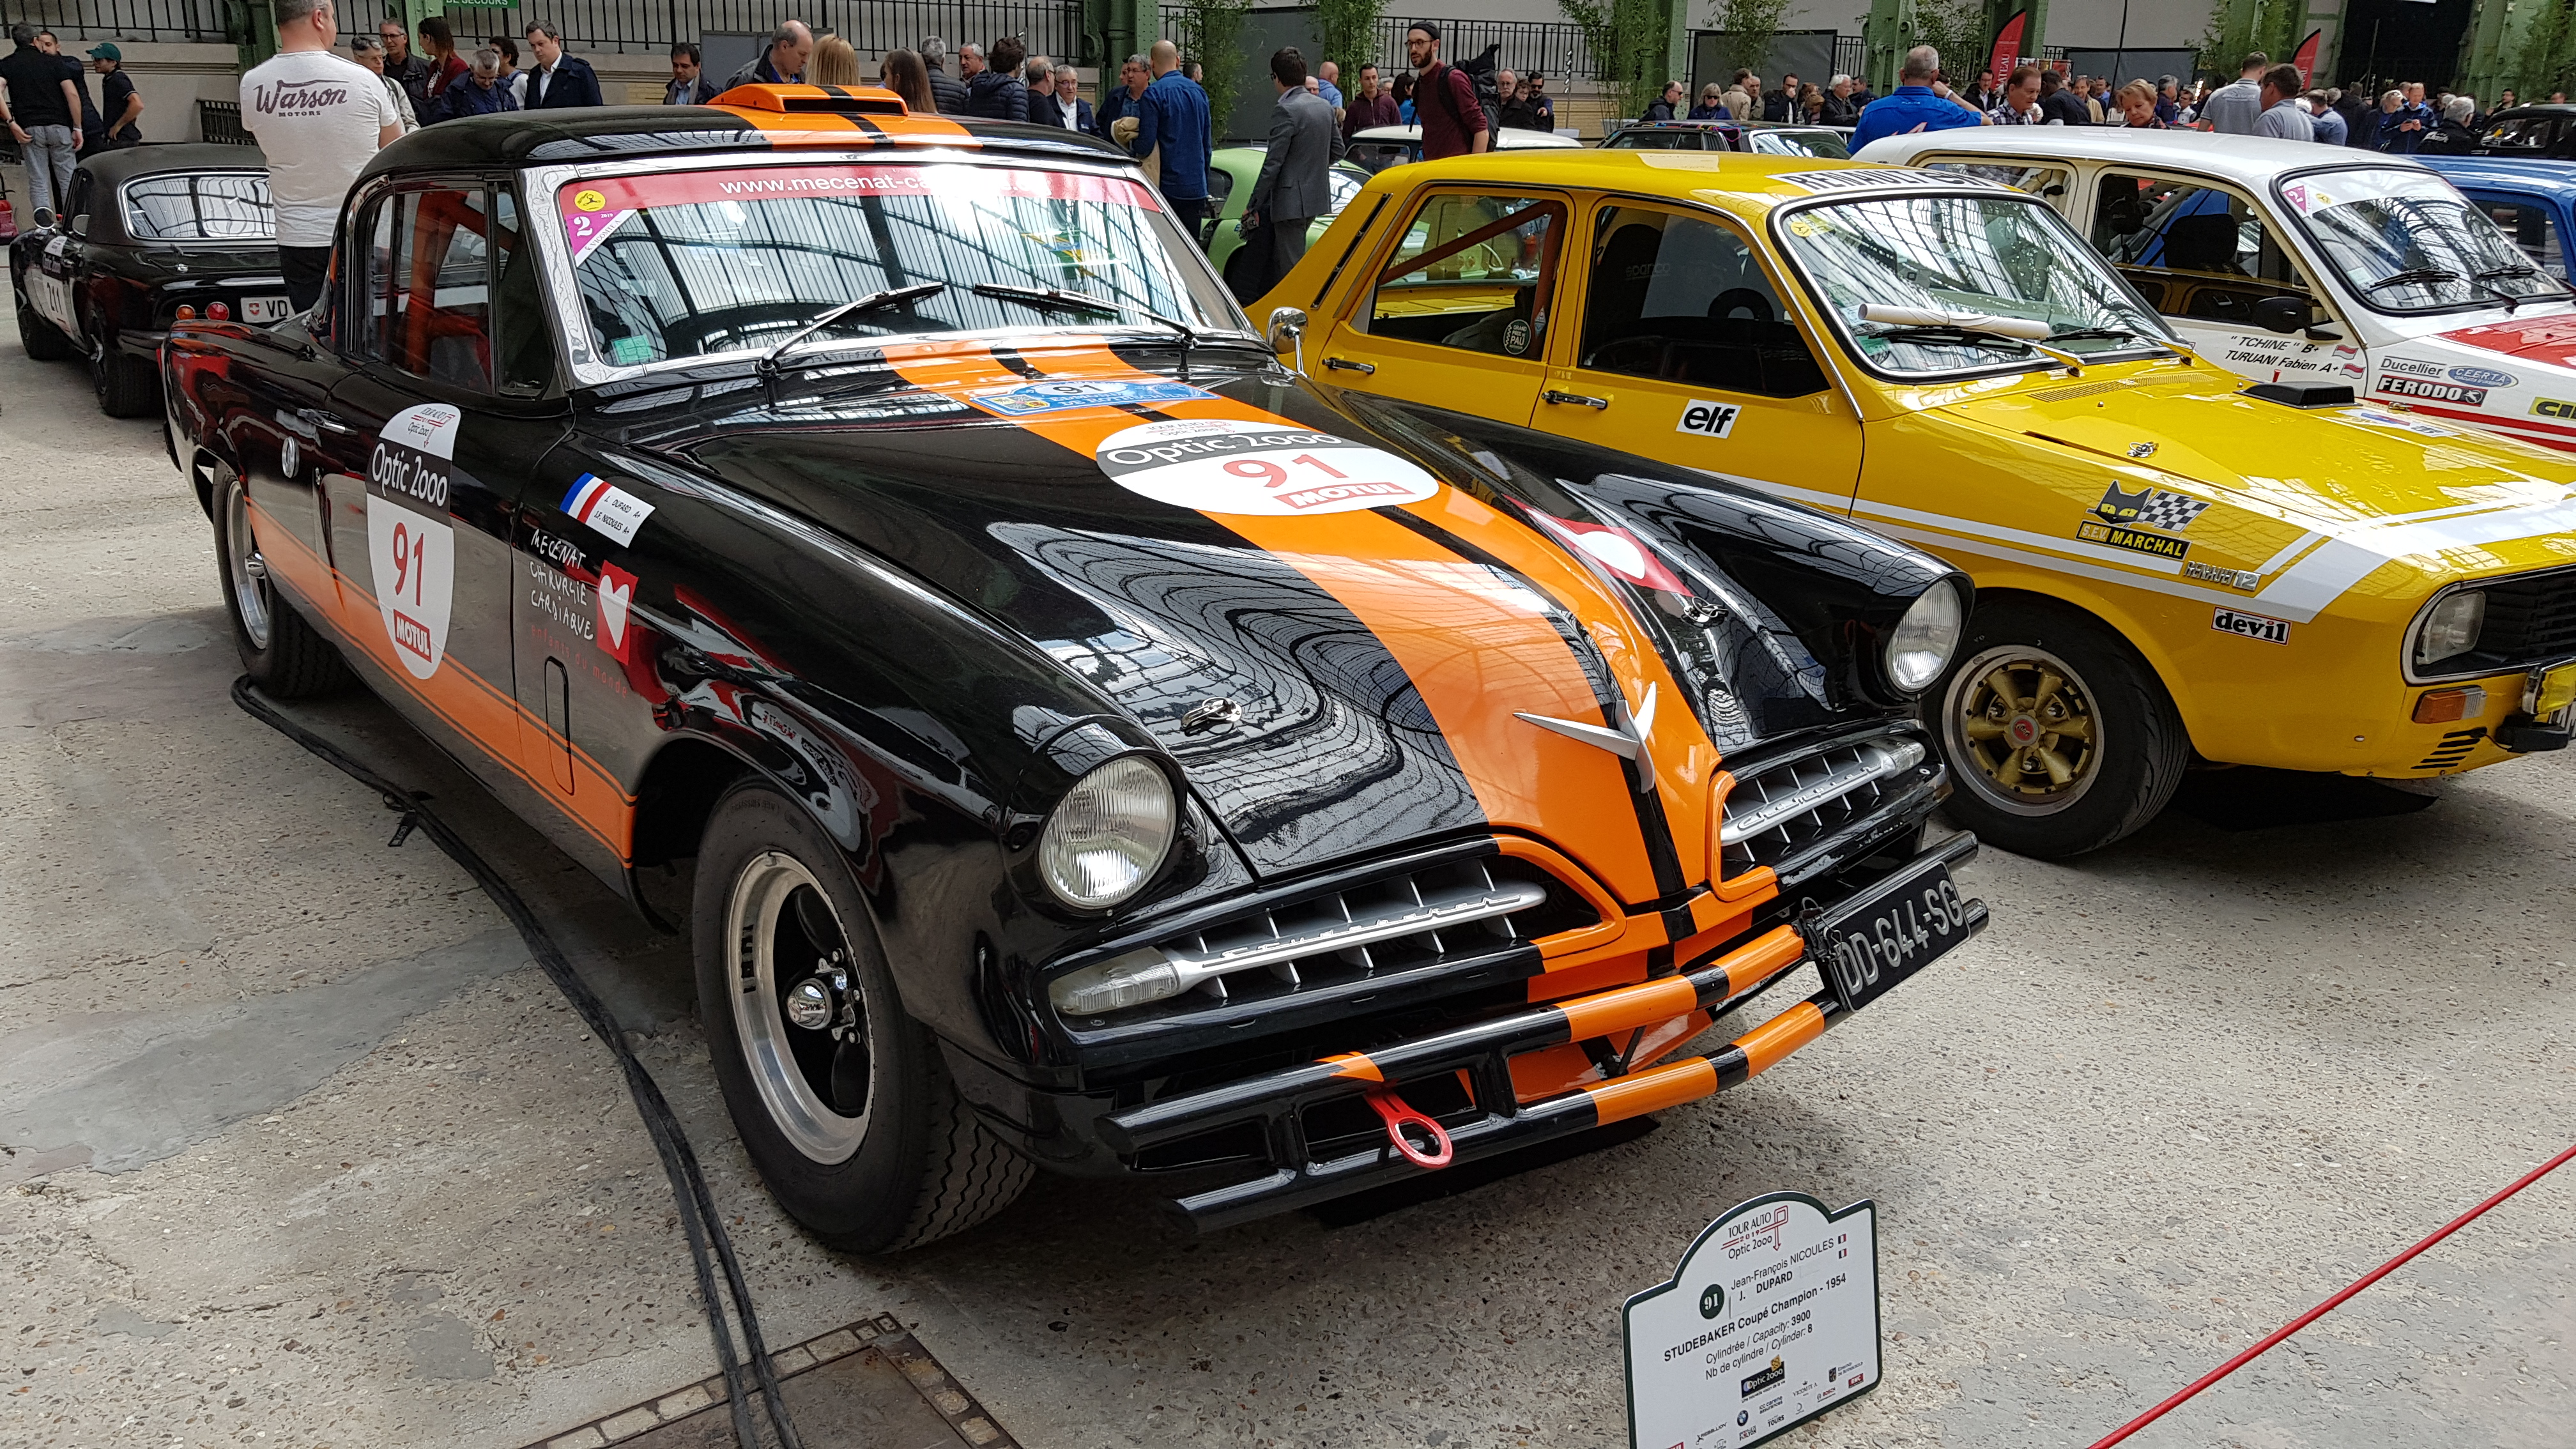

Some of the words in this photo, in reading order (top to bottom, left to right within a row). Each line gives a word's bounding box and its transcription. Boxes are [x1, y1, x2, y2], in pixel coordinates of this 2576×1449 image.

[1995, 54, 2010, 86] ATEAU
[253, 79, 349, 114] Warson
[1778, 171, 1928, 190] RENAULT
[574, 216, 593, 236] 2
[266, 300, 288, 318] VD
[1510, 335, 1525, 346] PAU
[2238, 337, 2290, 351] TCHINE
[2301, 344, 2320, 353] B+
[2225, 350, 2280, 365] TURUANI
[2278, 357, 2317, 371] Fabien
[2318, 363, 2339, 373] A+
[2380, 358, 2444, 376] Ducellier
[2456, 368, 2506, 383] CEERTA
[1052, 385, 1103, 394] 91
[2377, 377, 2462, 401] FERODO
[1684, 406, 1736, 433] elf
[1107, 439, 1238, 464] Optic
[1228, 434, 1342, 447] 2000
[372, 442, 410, 497] Optic
[410, 455, 448, 507] 2000
[1223, 454, 1349, 488] 91
[1287, 483, 1407, 507] MOTUL
[531, 528, 586, 569] MECENAT
[2082, 525, 2107, 541] S.E.V.
[2110, 530, 2182, 557] MARCHAL
[393, 522, 424, 607] 91
[2184, 560, 2238, 585] RENAULT
[2235, 572, 2258, 590] 12
[396, 616, 431, 657] MOTUL
[2215, 612, 2286, 641] devil
[531, 624, 571, 659] enfants
[575, 652, 587, 670] du
[593, 665, 628, 699] monde
[1736, 766, 1883, 831] Champion
[1833, 880, 1963, 997] DD-644-SG
[1728, 1221, 1749, 1238] TOUR
[1751, 1211, 1772, 1228] AUTO
[1740, 1229, 1759, 1242] 2019
[1728, 1245, 1751, 1260] Optic
[1752, 1235, 1772, 1250] 2000
[1731, 1259, 1788, 1291] Jean-François
[1790, 1238, 1834, 1266] NICOULES
[1738, 1290, 1746, 1301] J.
[1756, 1271, 1793, 1294] DUPARD
[1704, 1293, 1719, 1310] 91
[1664, 1322, 1735, 1363] STUDEBAKER
[1738, 1305, 1768, 1330] Coupé
[1771, 1286, 1818, 1315] Champion
[1825, 1272, 1846, 1291] 1954
[1706, 1339, 1745, 1365] Cylindrée
[1752, 1320, 1790, 1345] Capacity:
[1791, 1309, 1811, 1326] 3900
[1705, 1366, 1718, 1381] Nb
[1720, 1361, 1731, 1374] de
[1732, 1347, 1764, 1370] cylindre
[1771, 1328, 1805, 1351] Cylinder:
[1807, 1323, 1813, 1333] 8
[1766, 1367, 1783, 1381] 2000
[1767, 1414, 1784, 1427] TOURS
